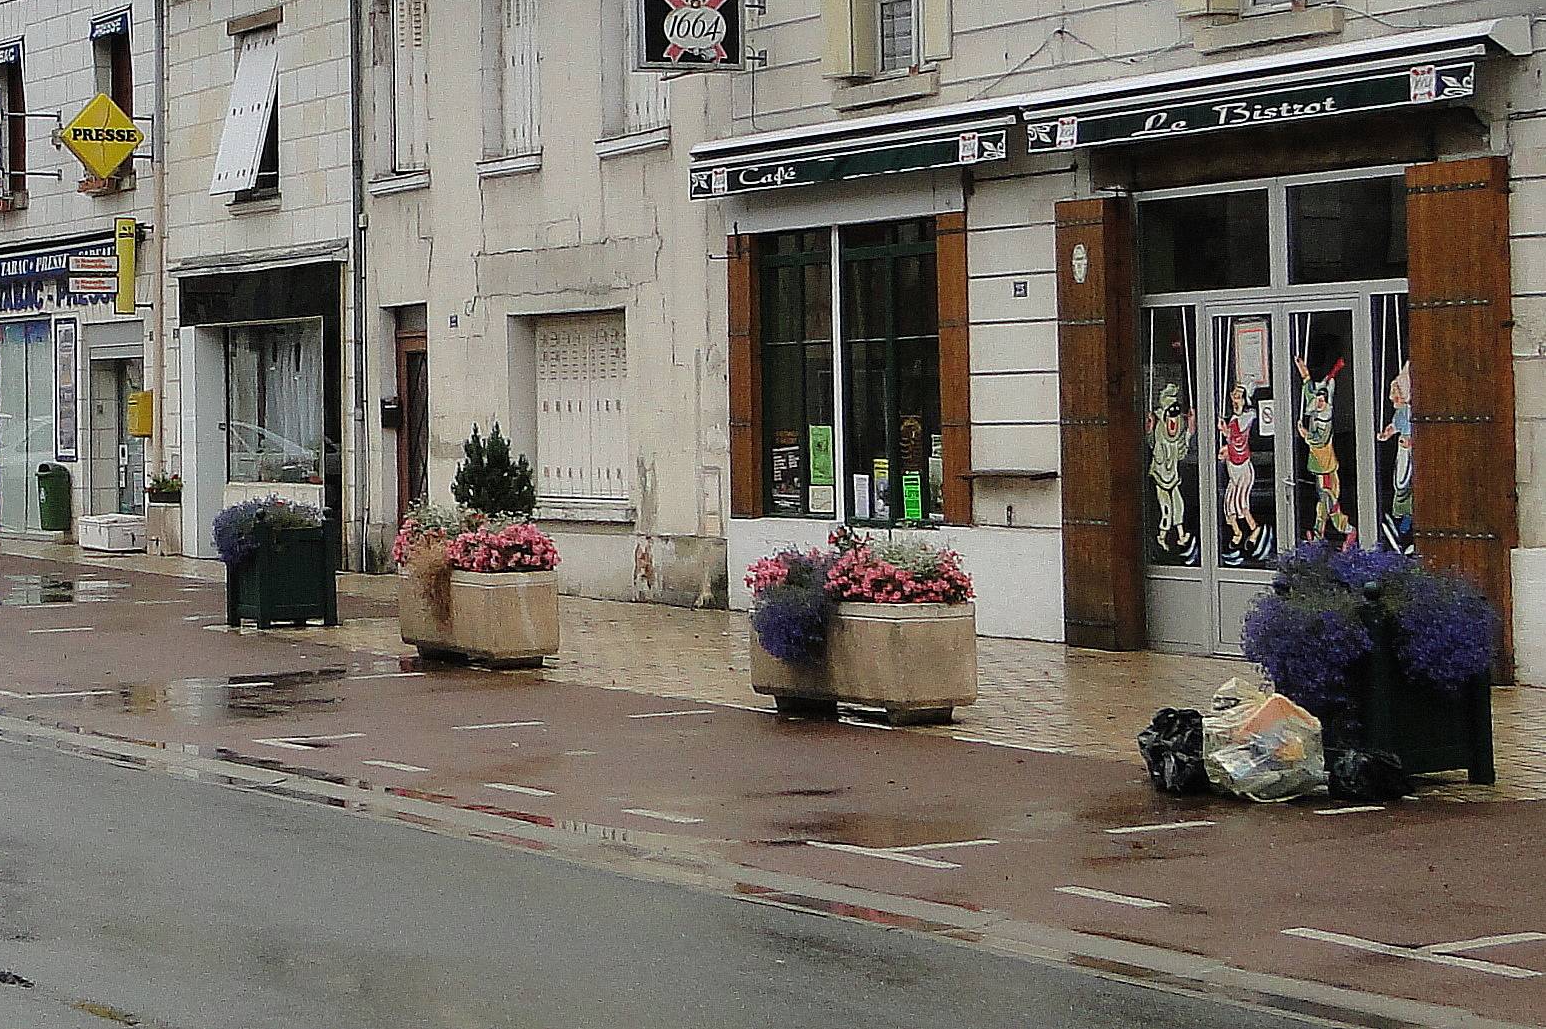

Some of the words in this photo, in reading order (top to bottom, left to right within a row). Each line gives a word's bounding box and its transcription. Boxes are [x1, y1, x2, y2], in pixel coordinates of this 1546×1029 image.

[669, 12, 723, 41] 1664
[1130, 112, 1189, 137] Le
[1211, 97, 1338, 125] Bistrot
[72, 128, 138, 143] PRESSE
[738, 166, 797, 185] Café
[0, 259, 29, 277] TABAC
